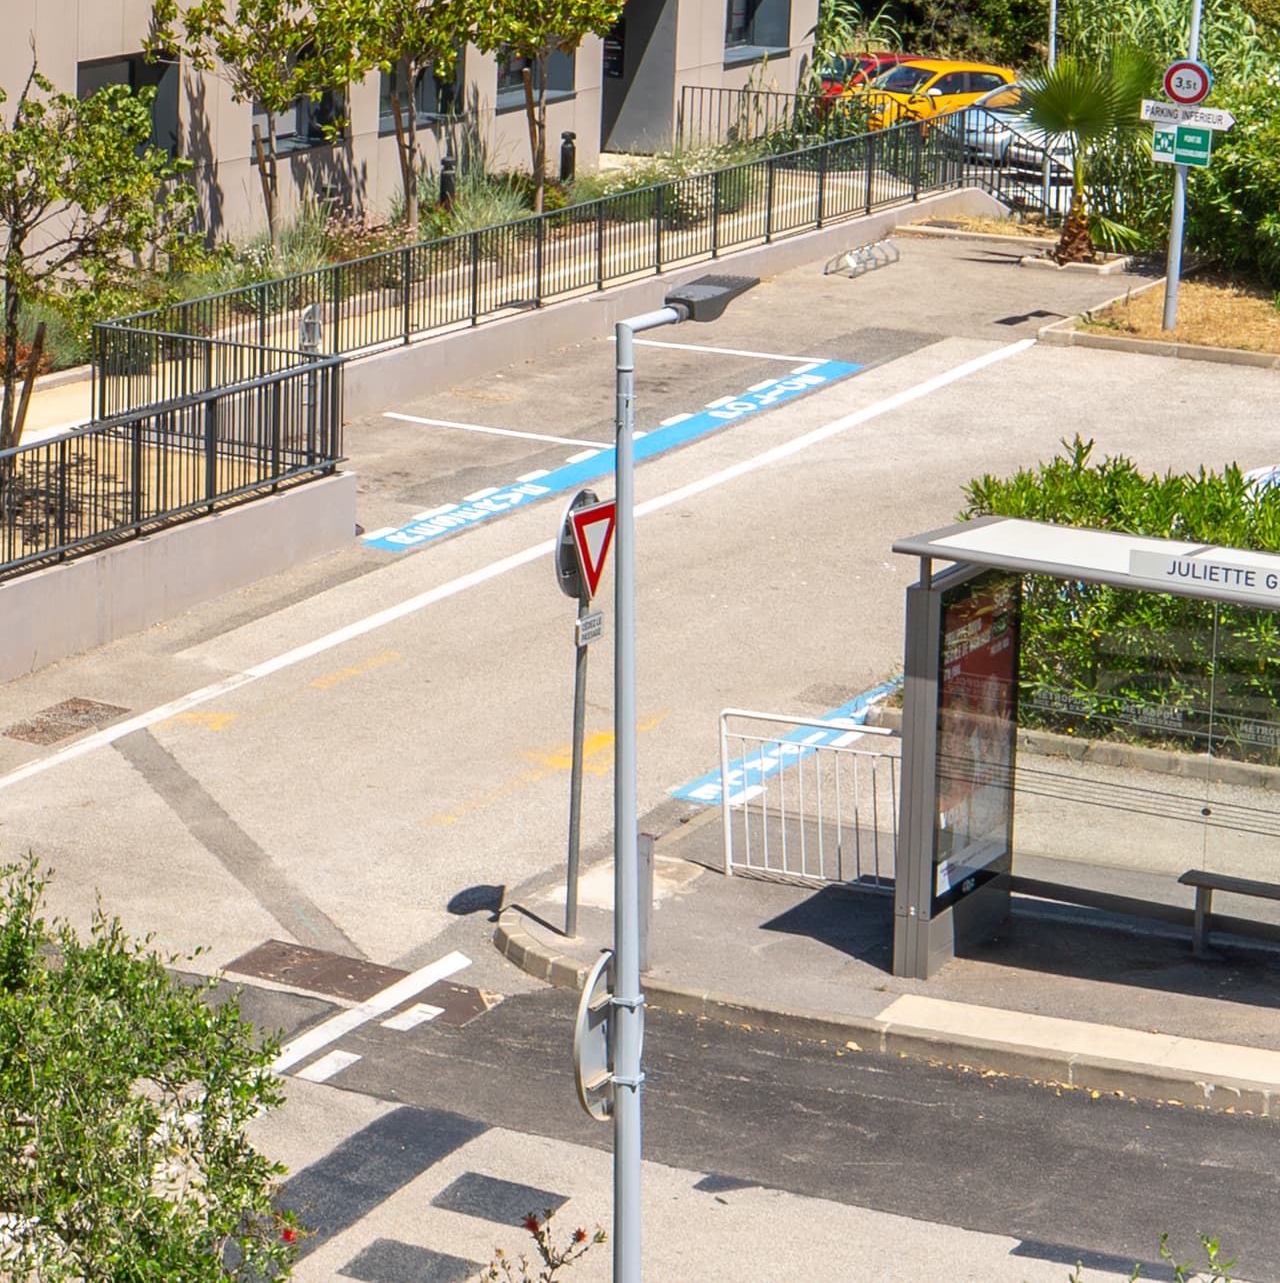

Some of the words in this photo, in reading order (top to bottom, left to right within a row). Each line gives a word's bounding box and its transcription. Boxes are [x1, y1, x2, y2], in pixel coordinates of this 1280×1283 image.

[1176, 77, 1197, 91] 3,5t
[1145, 105, 1179, 119] PARKING
[1167, 560, 1256, 587] JULIETTE
[1266, 574, 1280, 589] G
